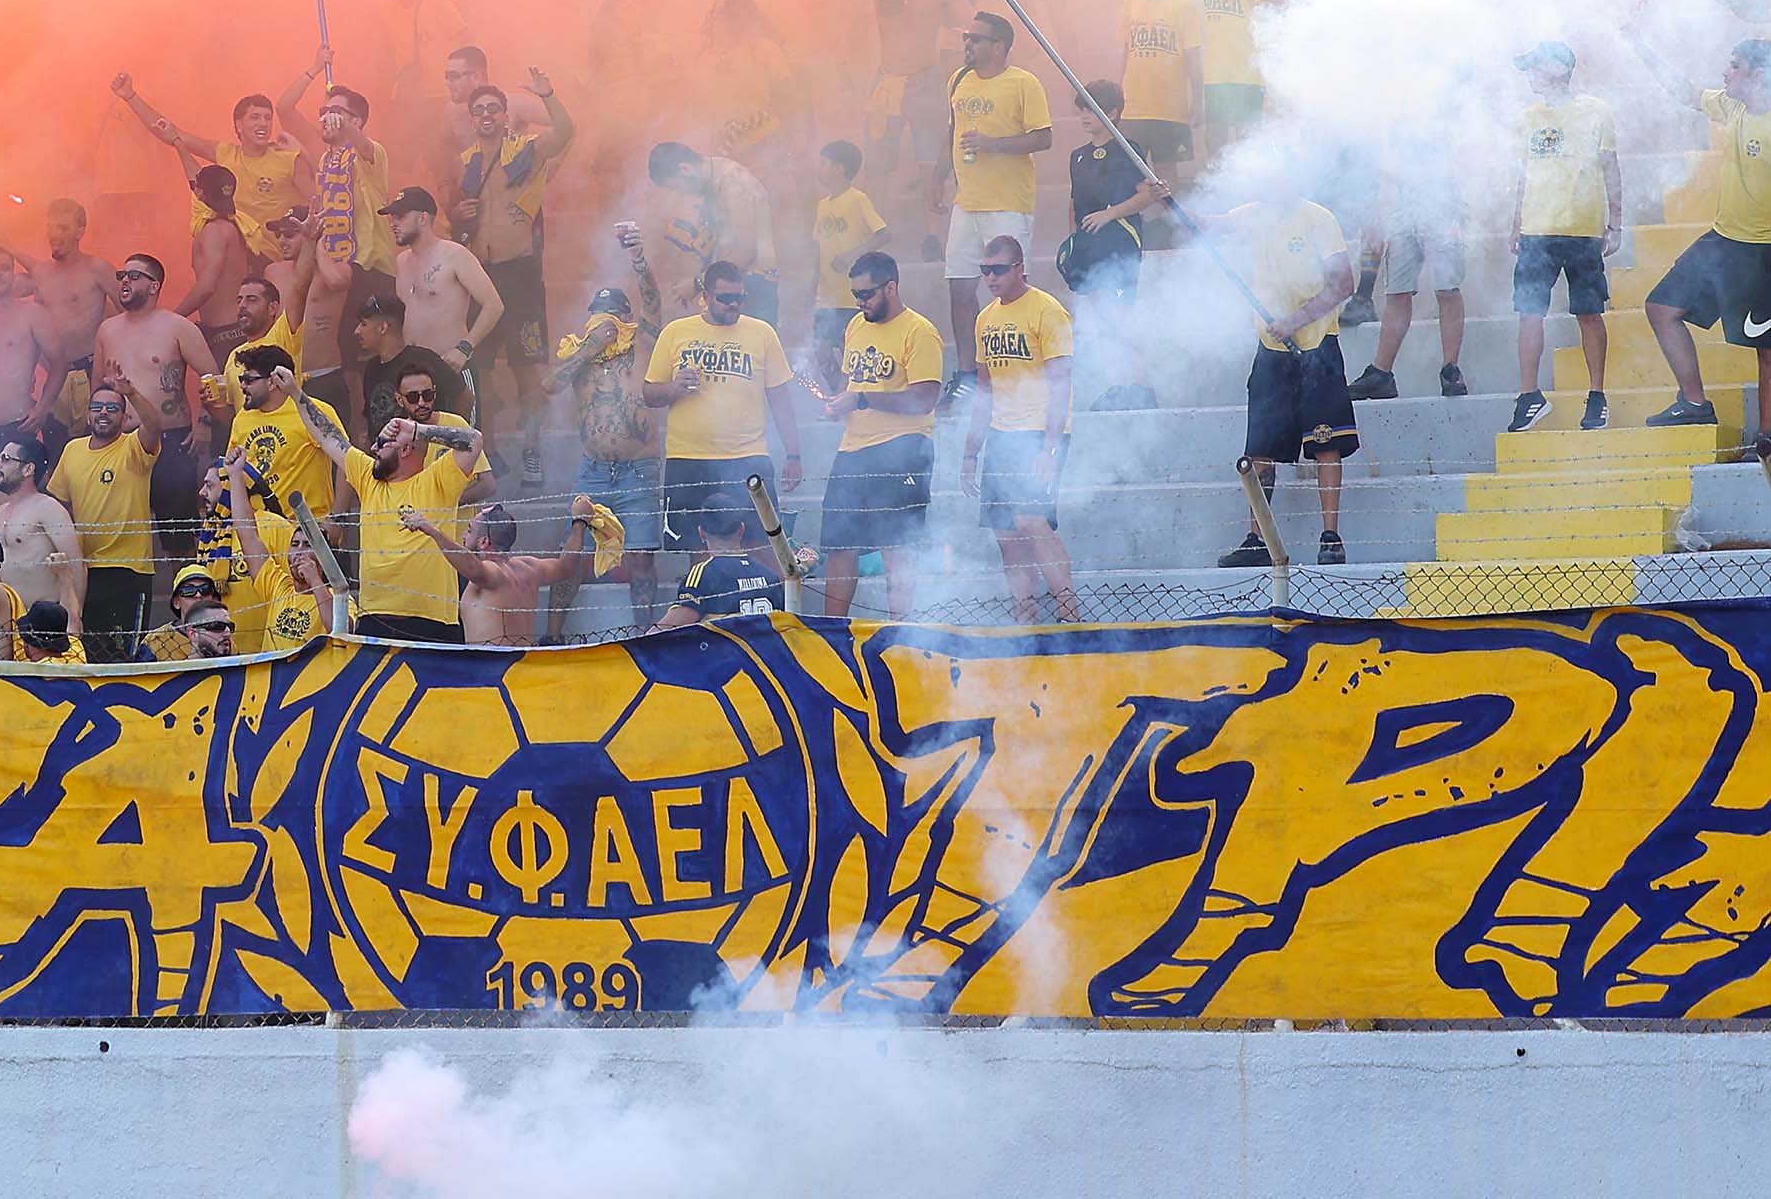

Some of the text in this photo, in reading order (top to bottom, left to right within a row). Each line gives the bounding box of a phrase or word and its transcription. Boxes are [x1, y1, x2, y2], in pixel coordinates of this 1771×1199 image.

[1129, 24, 1176, 51] ΥΦΑΕΛ
[982, 332, 1031, 358] ΥΦΑΕΛ
[678, 349, 753, 378] ΣΥΦΑΕΛ
[489, 961, 640, 1011] 1989
